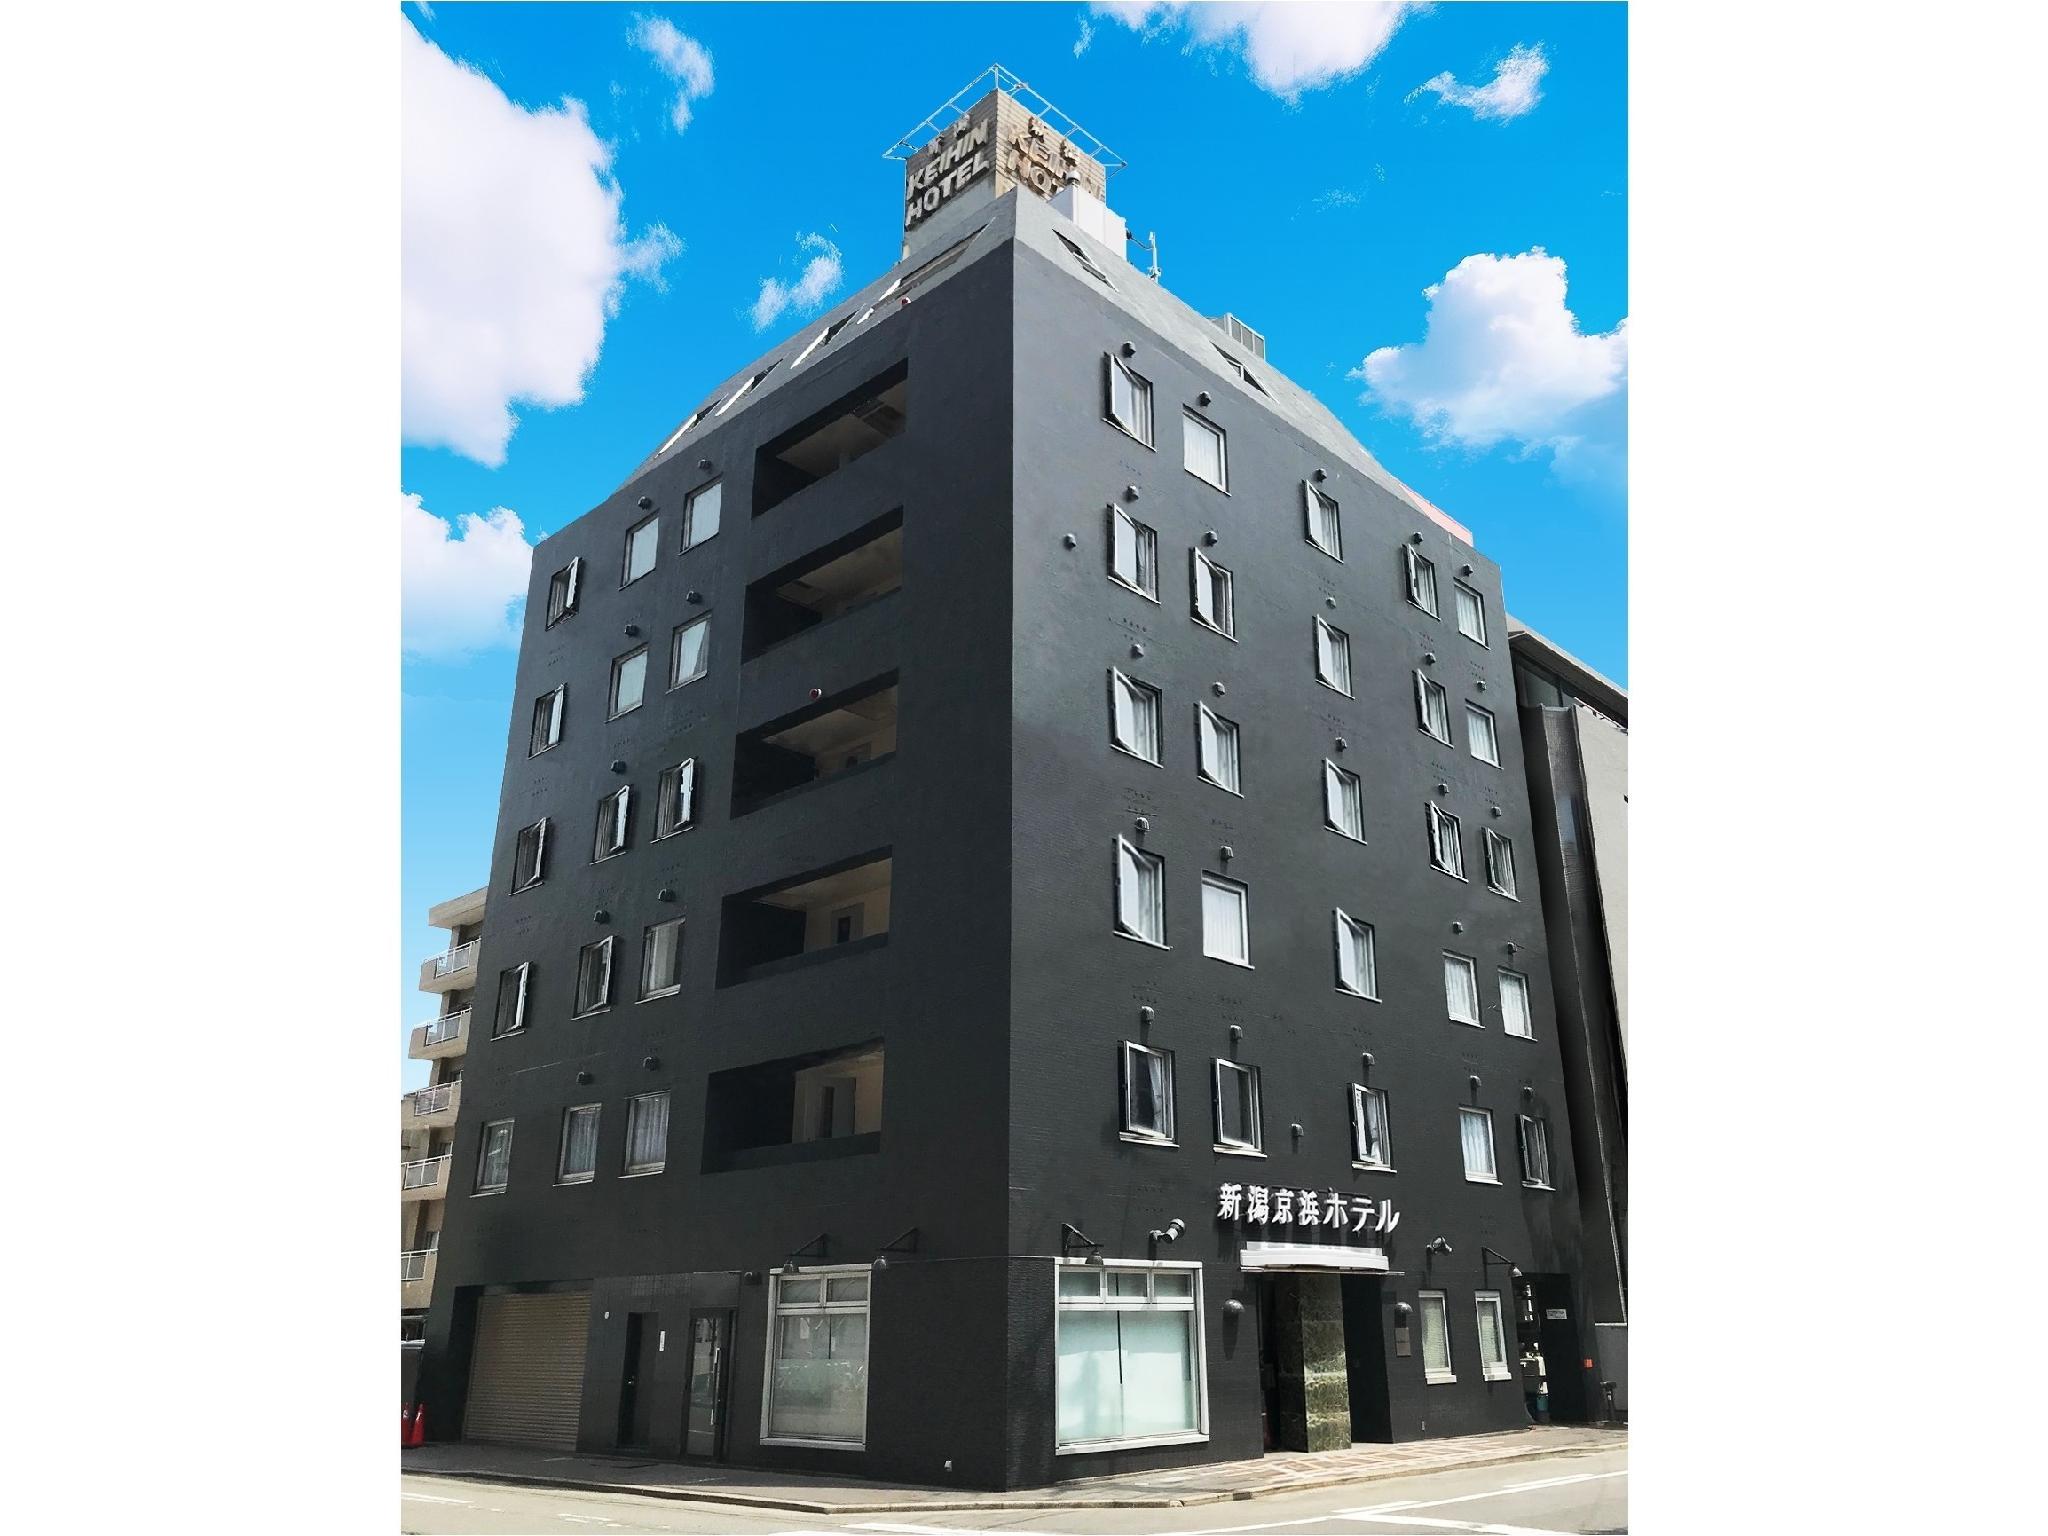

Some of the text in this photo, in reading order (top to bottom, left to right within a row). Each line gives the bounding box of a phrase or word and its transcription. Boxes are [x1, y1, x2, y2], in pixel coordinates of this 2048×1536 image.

[906, 118, 989, 201] KEIHIN
[906, 151, 990, 226] HOTEL
[1217, 1182, 1400, 1233] 新潟京浜ホテル
